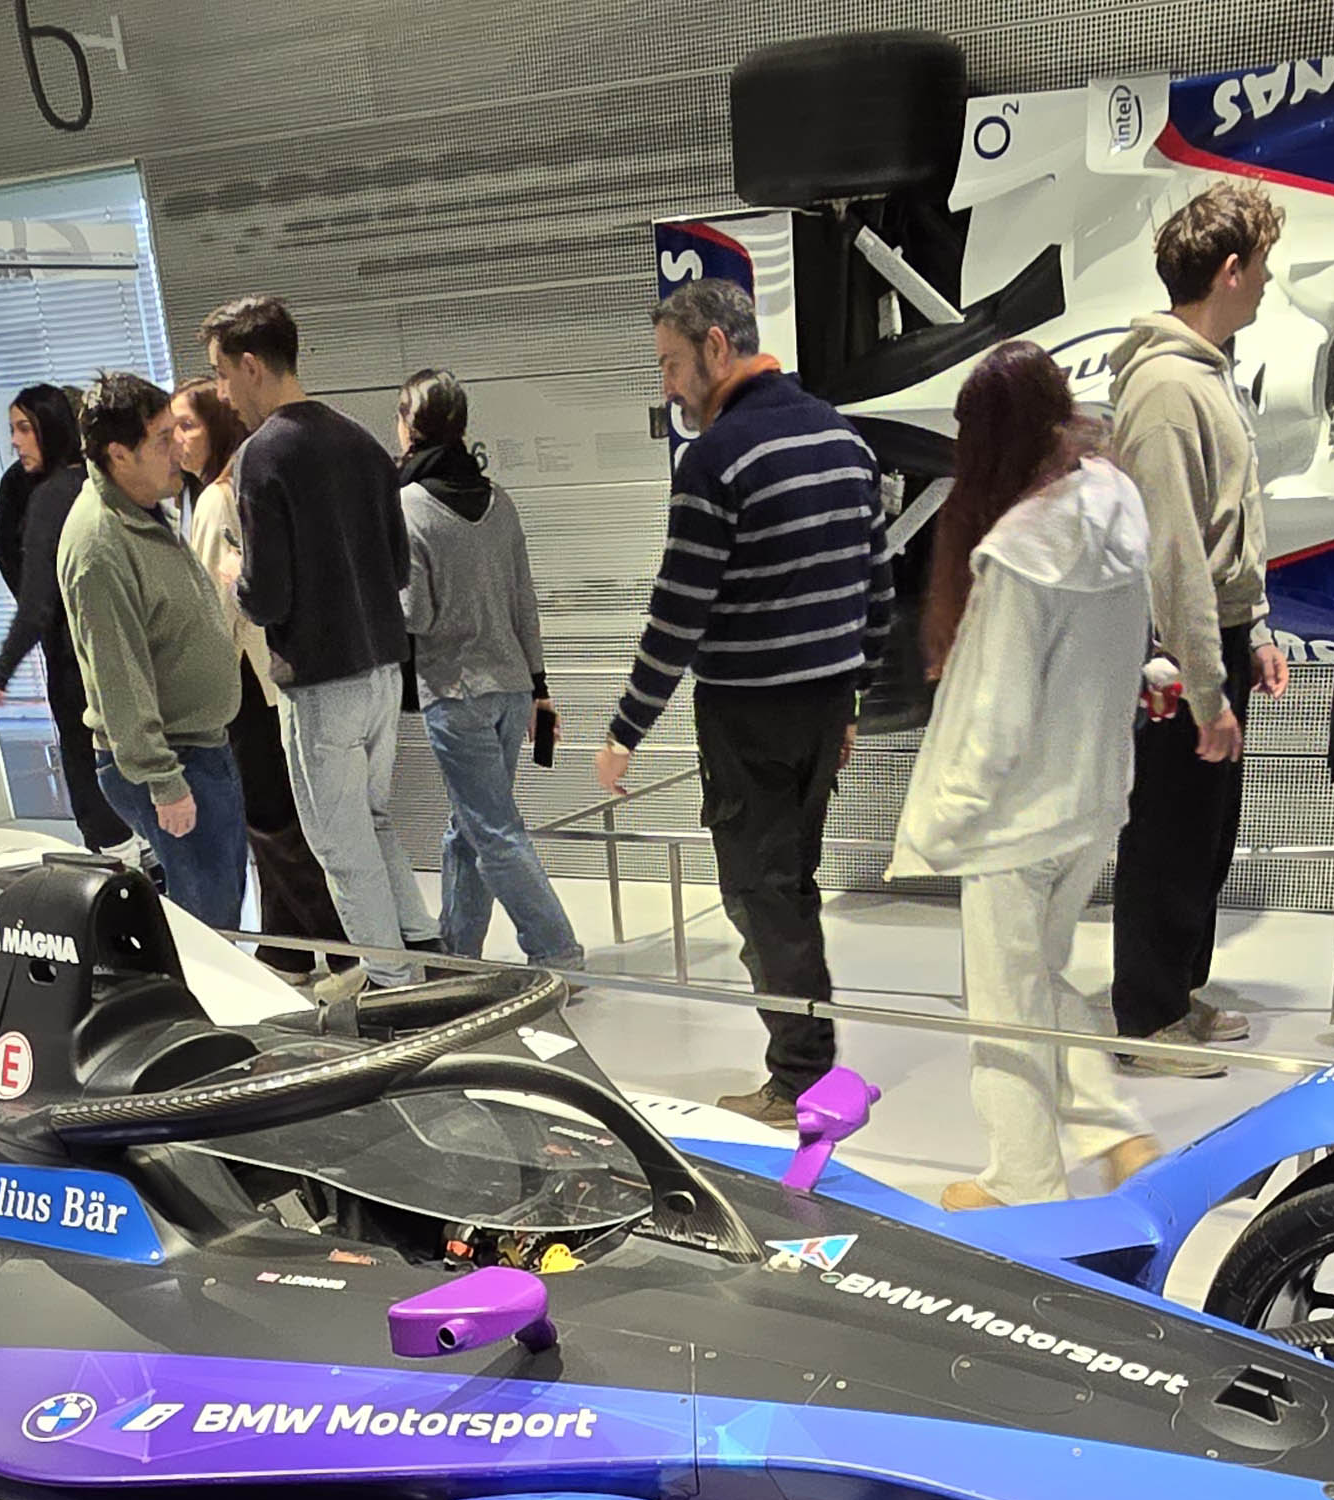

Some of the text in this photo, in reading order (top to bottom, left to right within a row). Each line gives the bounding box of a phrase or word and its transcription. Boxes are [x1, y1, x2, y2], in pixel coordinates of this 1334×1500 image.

[1114, 94, 1131, 152] intel
[2, 925, 80, 964] MAGNA
[1, 1043, 22, 1089] E
[59, 1186, 127, 1235] Bär
[835, 1273, 1190, 1396] BMW Motorsport
[192, 1403, 597, 1443] BMW Motorsport
